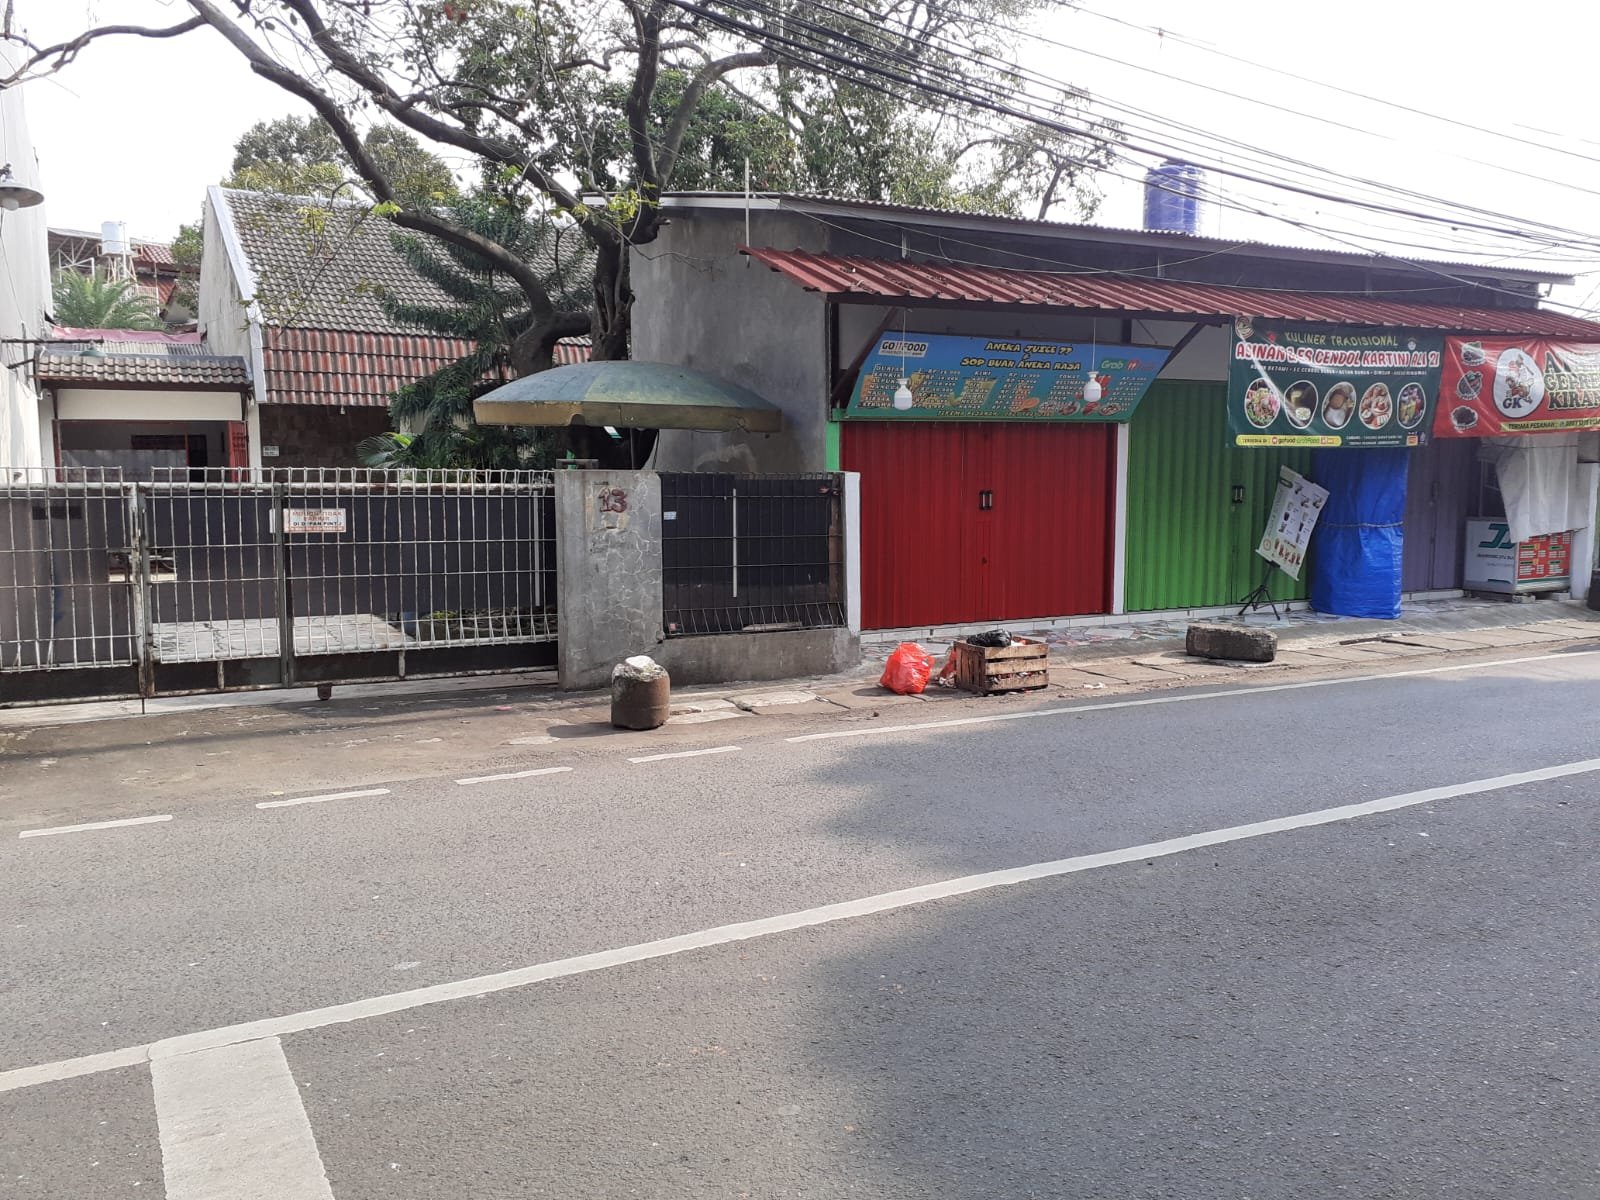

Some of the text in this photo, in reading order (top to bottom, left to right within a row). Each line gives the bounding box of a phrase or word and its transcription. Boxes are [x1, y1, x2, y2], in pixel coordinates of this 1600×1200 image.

[1285, 332, 1398, 347] KULINER TRADISIONAL
[985, 342, 1021, 353] ANEKA
[1236, 342, 1286, 362] ASINAN
[1314, 348, 1360, 367] CENDOL
[1362, 350, 1410, 367] KARTINI
[961, 357, 1081, 371] SOP BUAH ANEKA RASA
[1101, 360, 1124, 369] Grab
[1502, 397, 1522, 409] GK
[598, 488, 628, 513] 13
